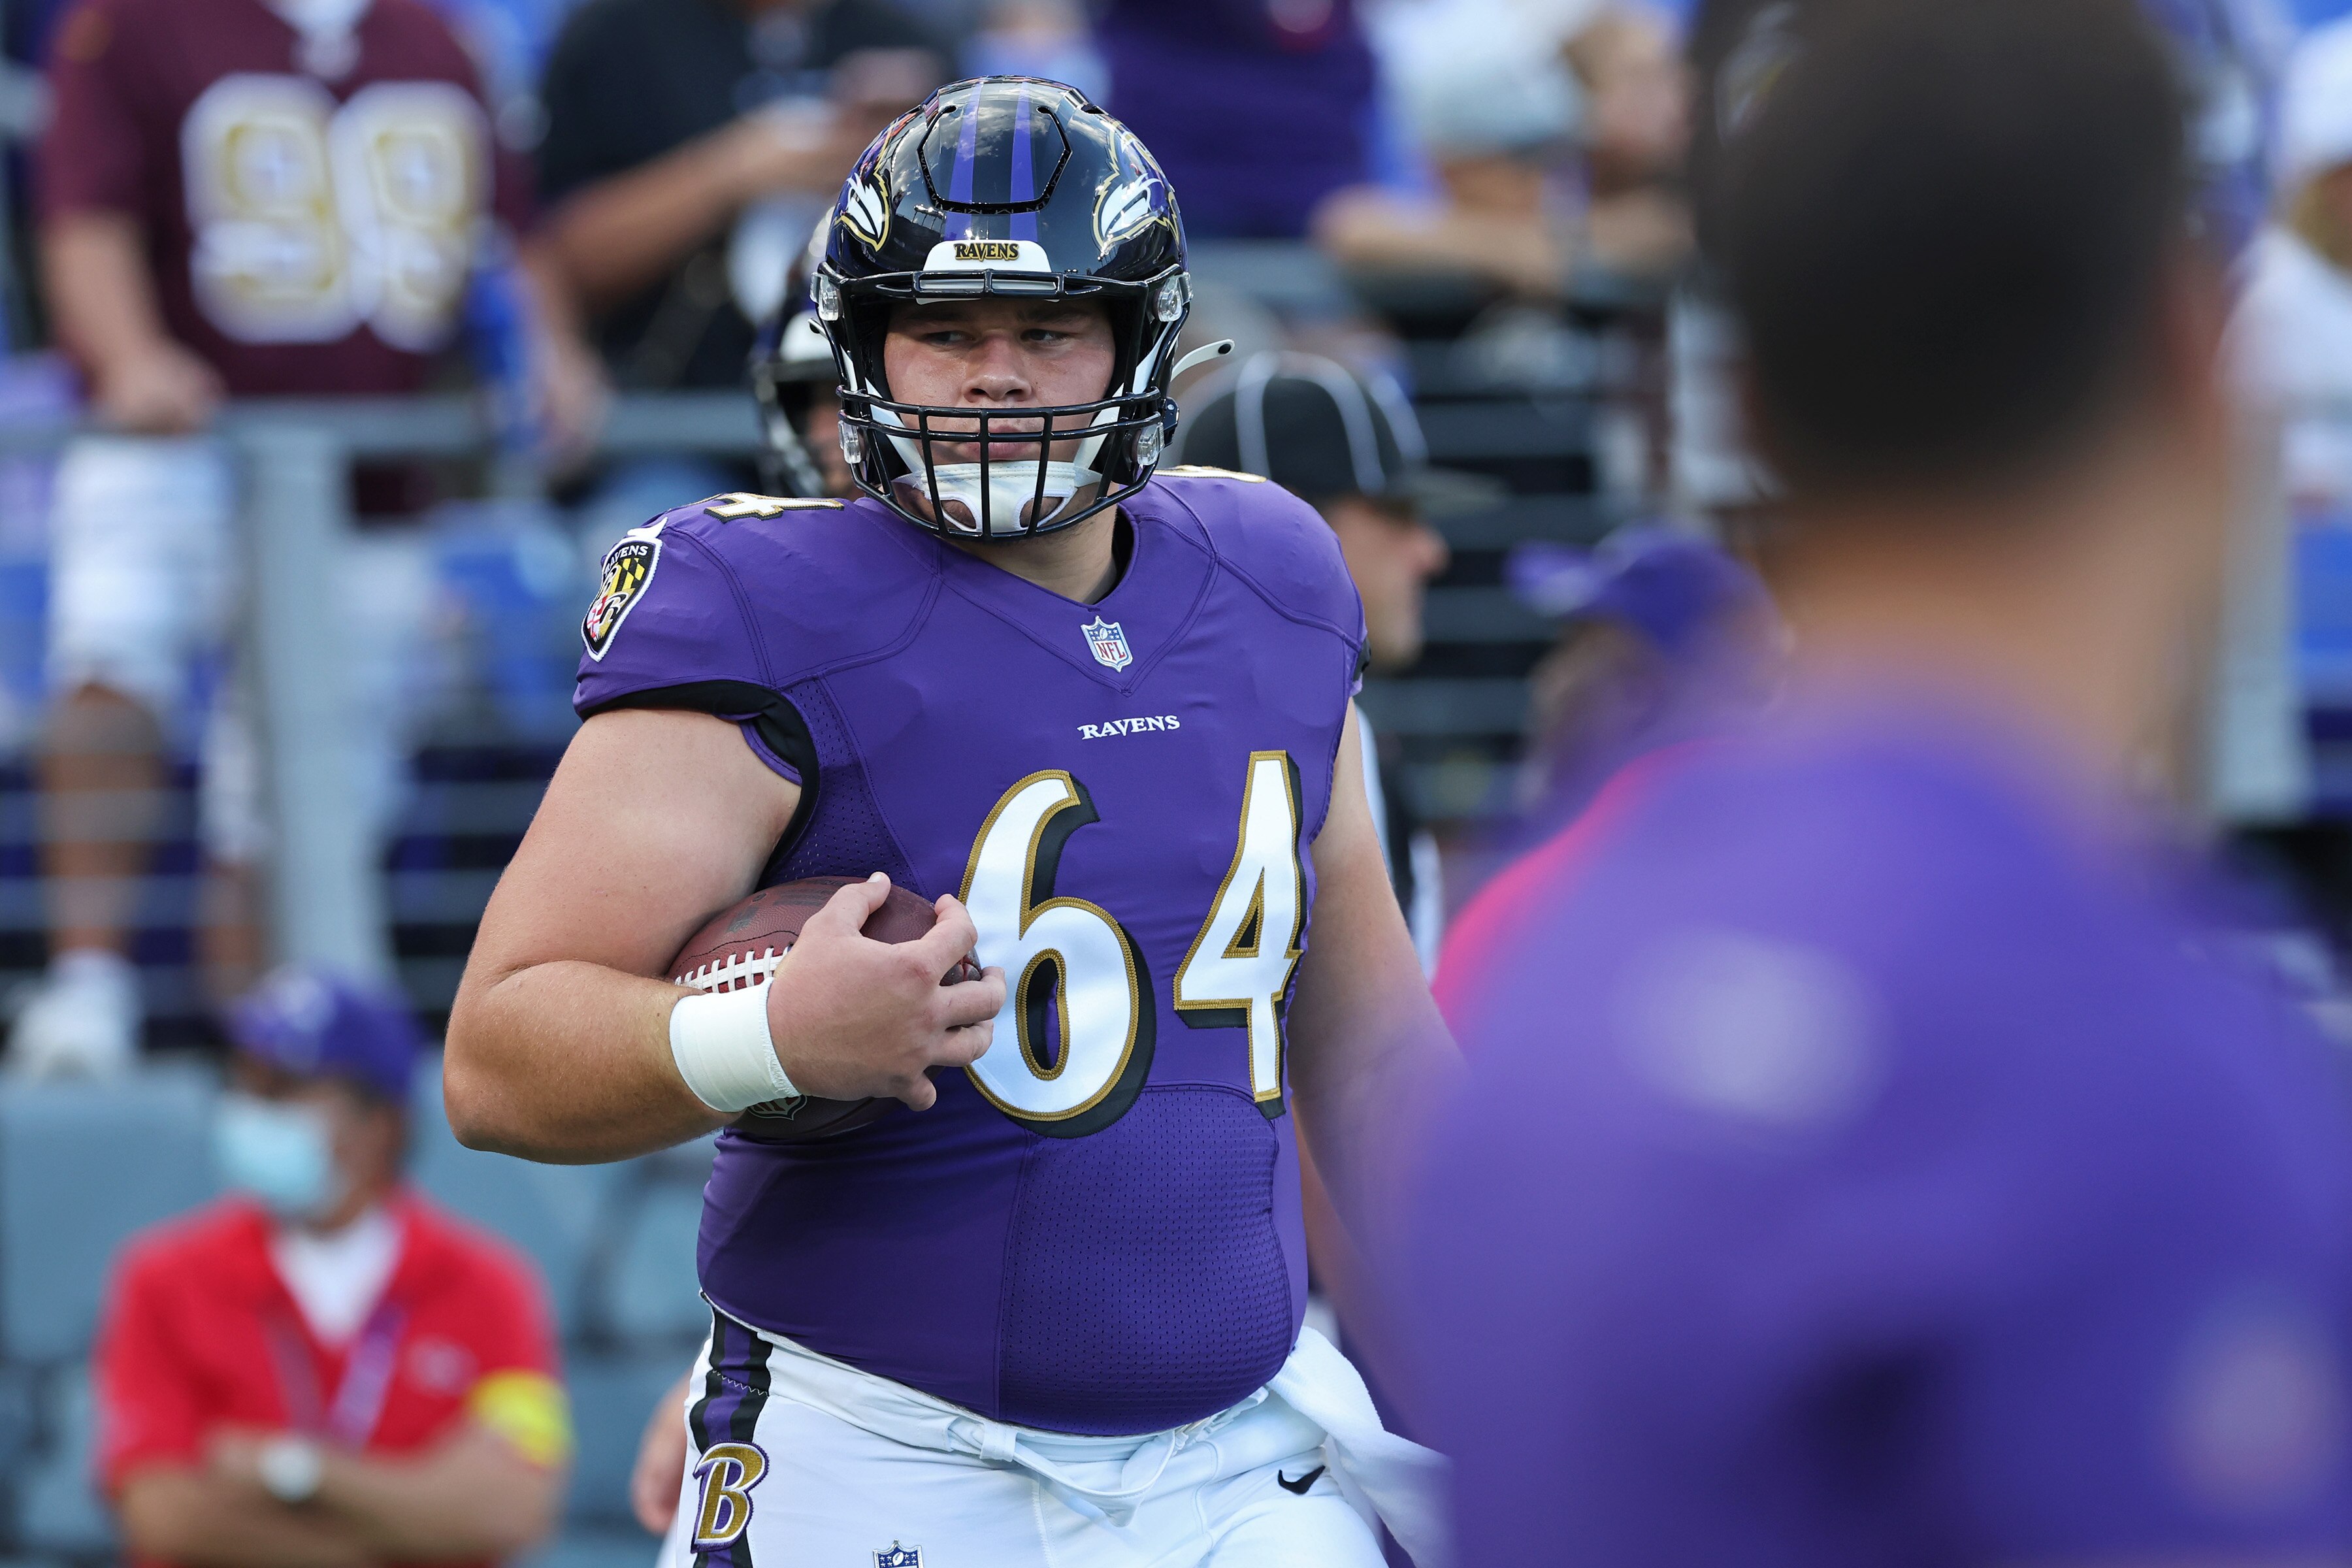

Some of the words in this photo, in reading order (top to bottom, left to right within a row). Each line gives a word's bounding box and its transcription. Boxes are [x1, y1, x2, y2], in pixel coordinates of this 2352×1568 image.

[954, 242, 1019, 261] RAVENS
[604, 545, 649, 577] RAVENS
[1096, 641, 1126, 661] NFL
[1077, 714, 1181, 740] RAVENS
[956, 749, 1303, 1139] 64
[690, 1439, 770, 1554] B
